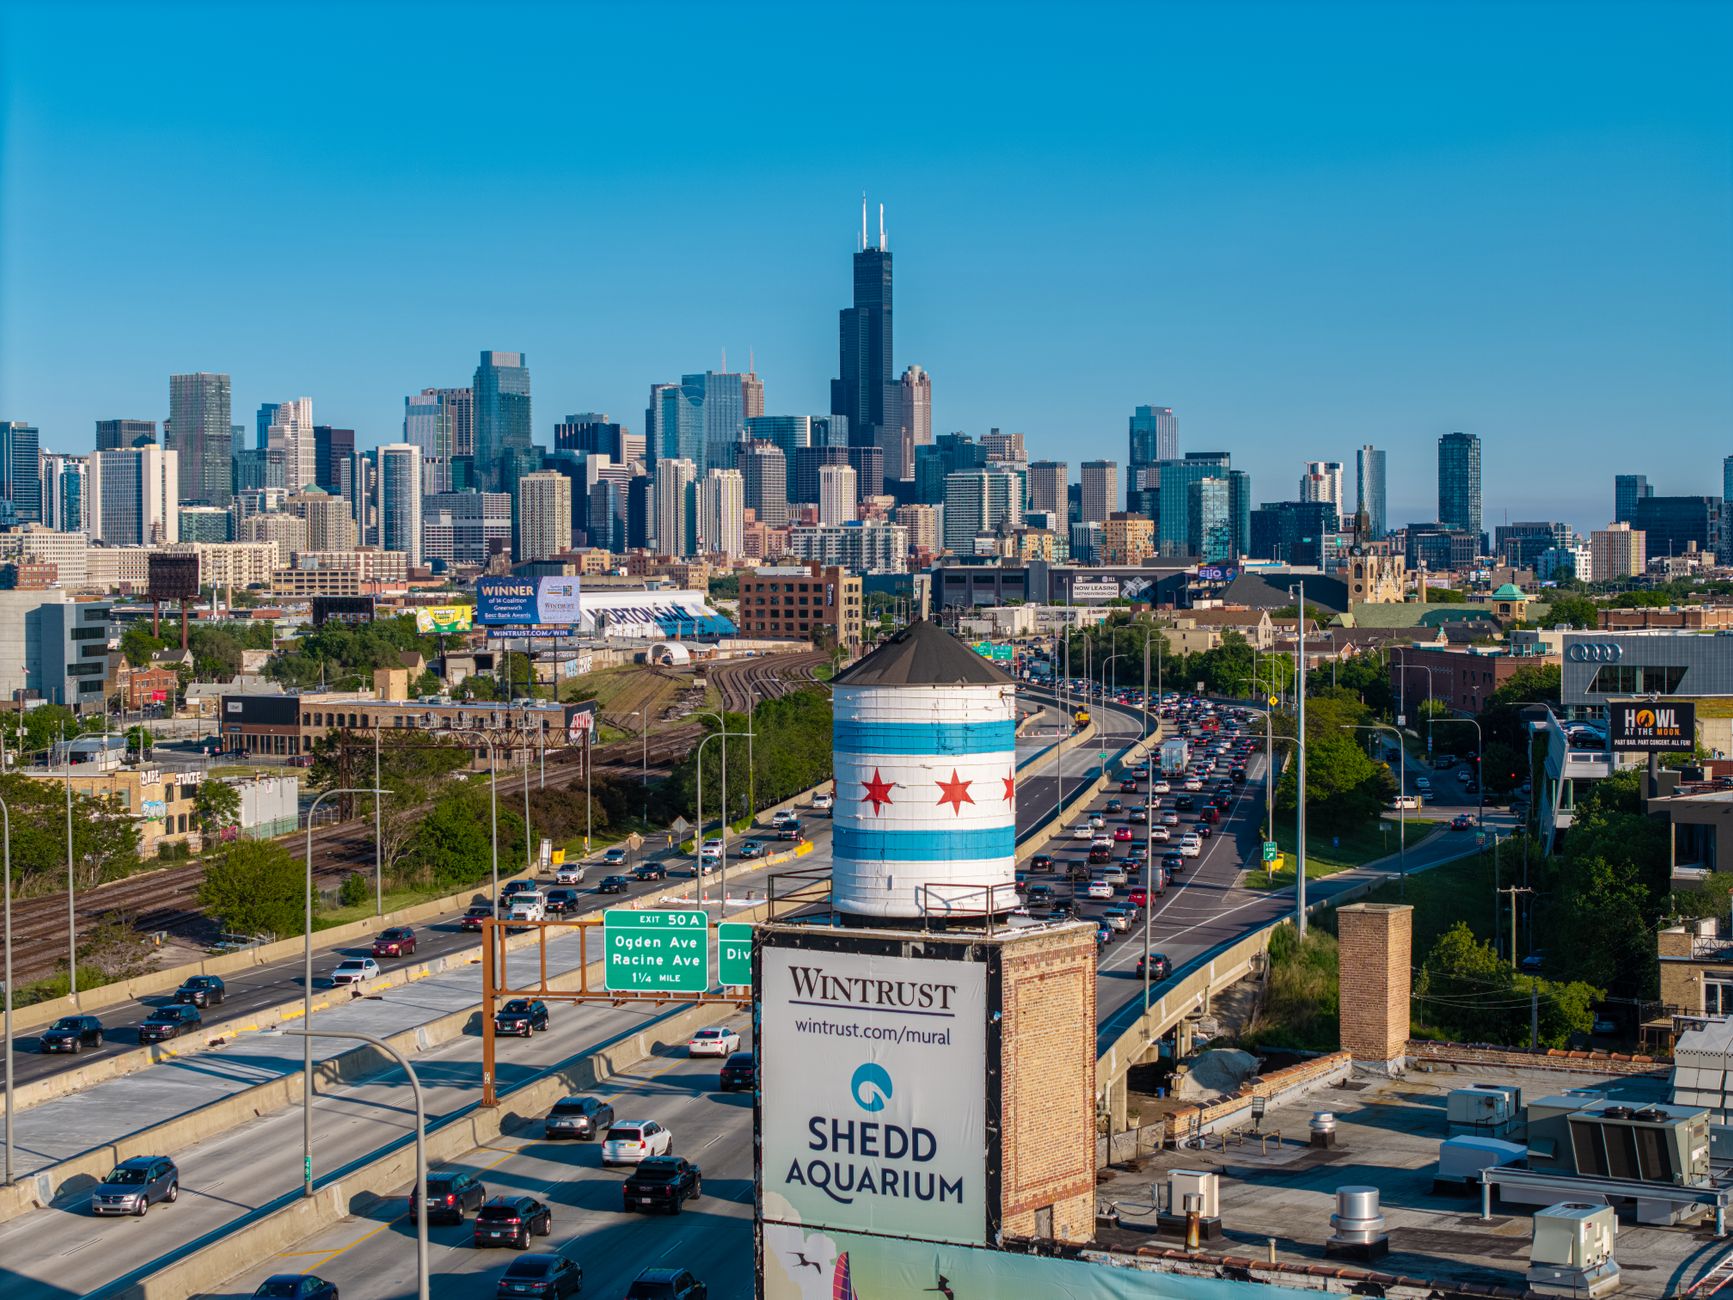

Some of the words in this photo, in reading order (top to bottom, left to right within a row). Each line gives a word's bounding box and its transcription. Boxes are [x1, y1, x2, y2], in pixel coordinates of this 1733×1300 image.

[481, 586, 534, 596] WINNER
[654, 606, 695, 621] SALT
[1624, 709, 1679, 728] HOWL
[615, 936, 661, 950] Ogden
[669, 937, 697, 949] Ave
[613, 953, 663, 966] Racine
[672, 955, 700, 966] Ave
[659, 974, 681, 982] MILE
[788, 966, 957, 1010] WINTRUST
[795, 1017, 951, 1046] wintrust.com/mural
[808, 1115, 938, 1163] SHEDD
[785, 1157, 964, 1204] AQUARIUM
